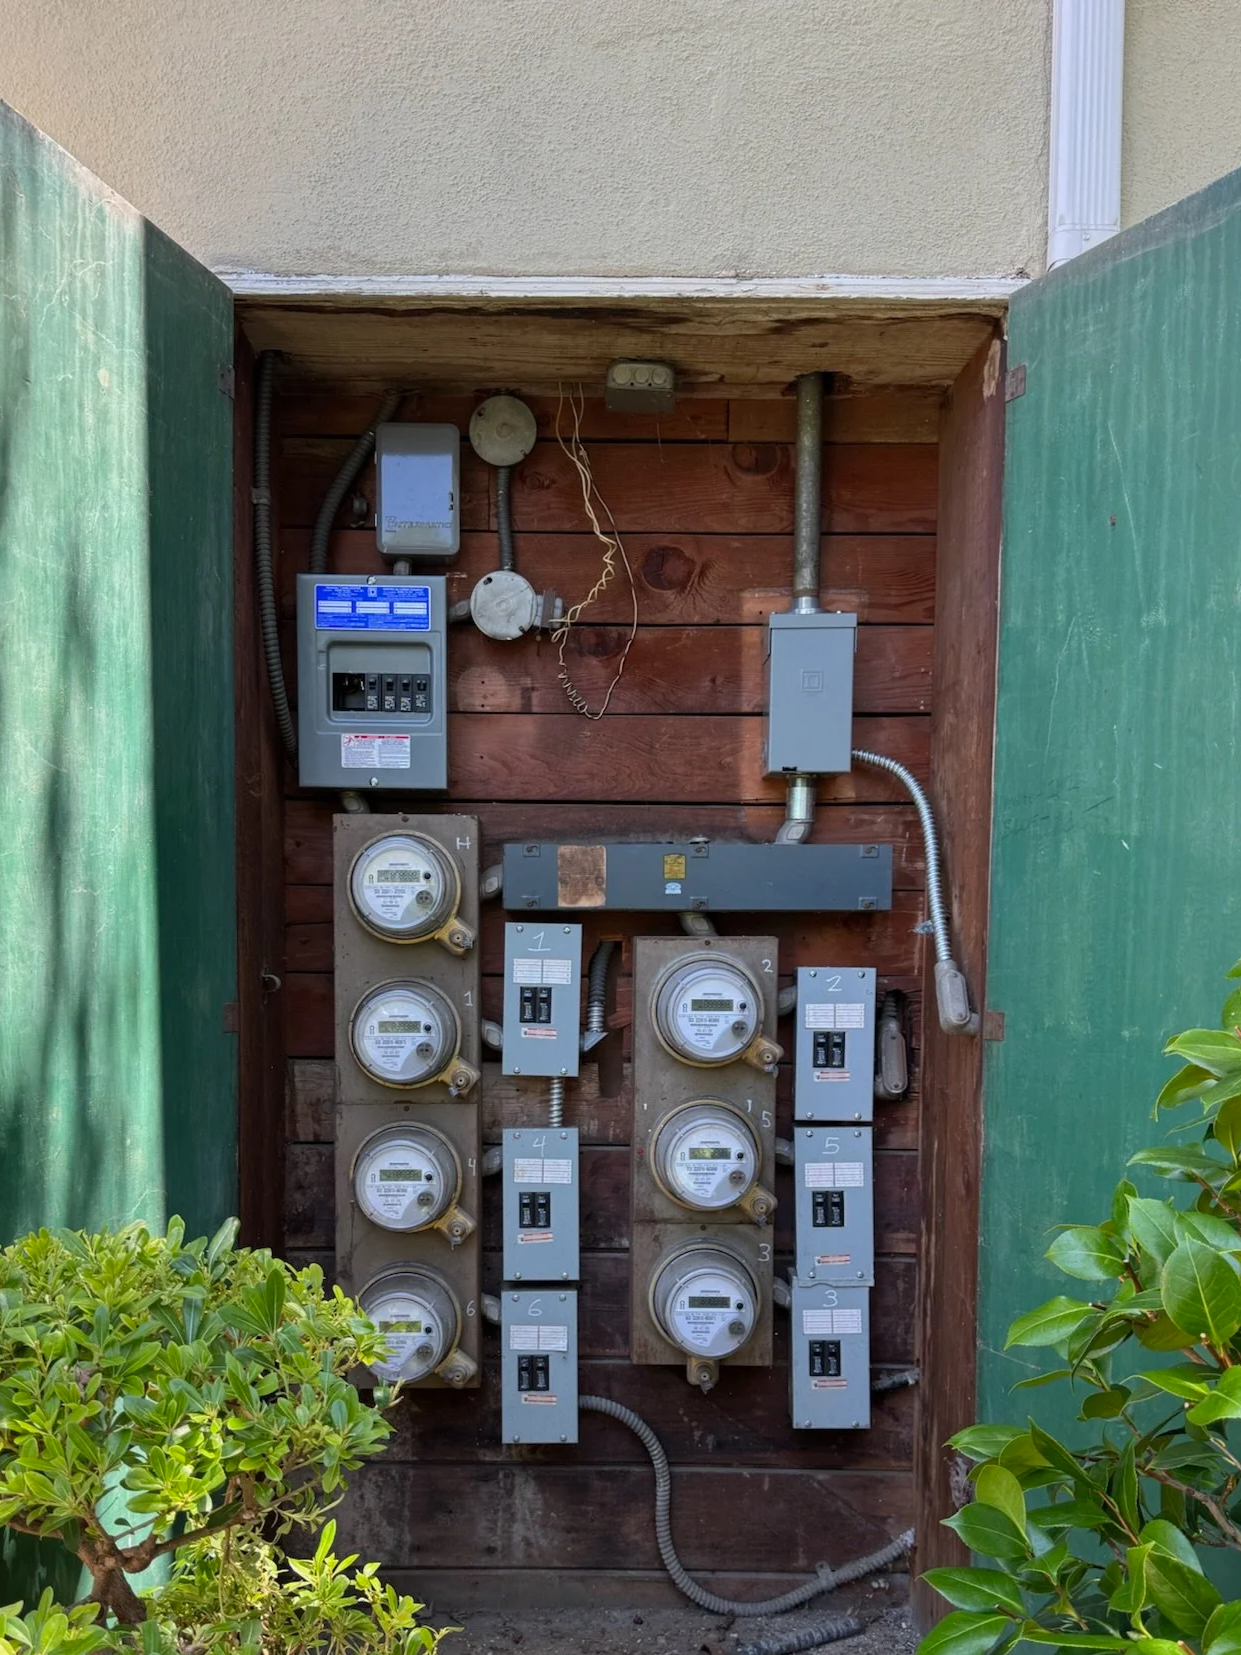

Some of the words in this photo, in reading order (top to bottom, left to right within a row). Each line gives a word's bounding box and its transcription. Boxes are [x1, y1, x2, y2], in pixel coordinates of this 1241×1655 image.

[456, 836, 471, 850] H
[527, 931, 551, 952] 1
[761, 959, 773, 973] 2
[825, 975, 843, 992] 2
[463, 990, 473, 1007] 1
[761, 1110, 772, 1128] 5
[532, 1135, 547, 1157] 4
[822, 1136, 840, 1155] 5
[468, 1158, 477, 1176] 4
[757, 1243, 771, 1262] 3
[527, 1298, 543, 1317] 6
[822, 1289, 838, 1308] 3
[466, 1299, 476, 1317] 6
